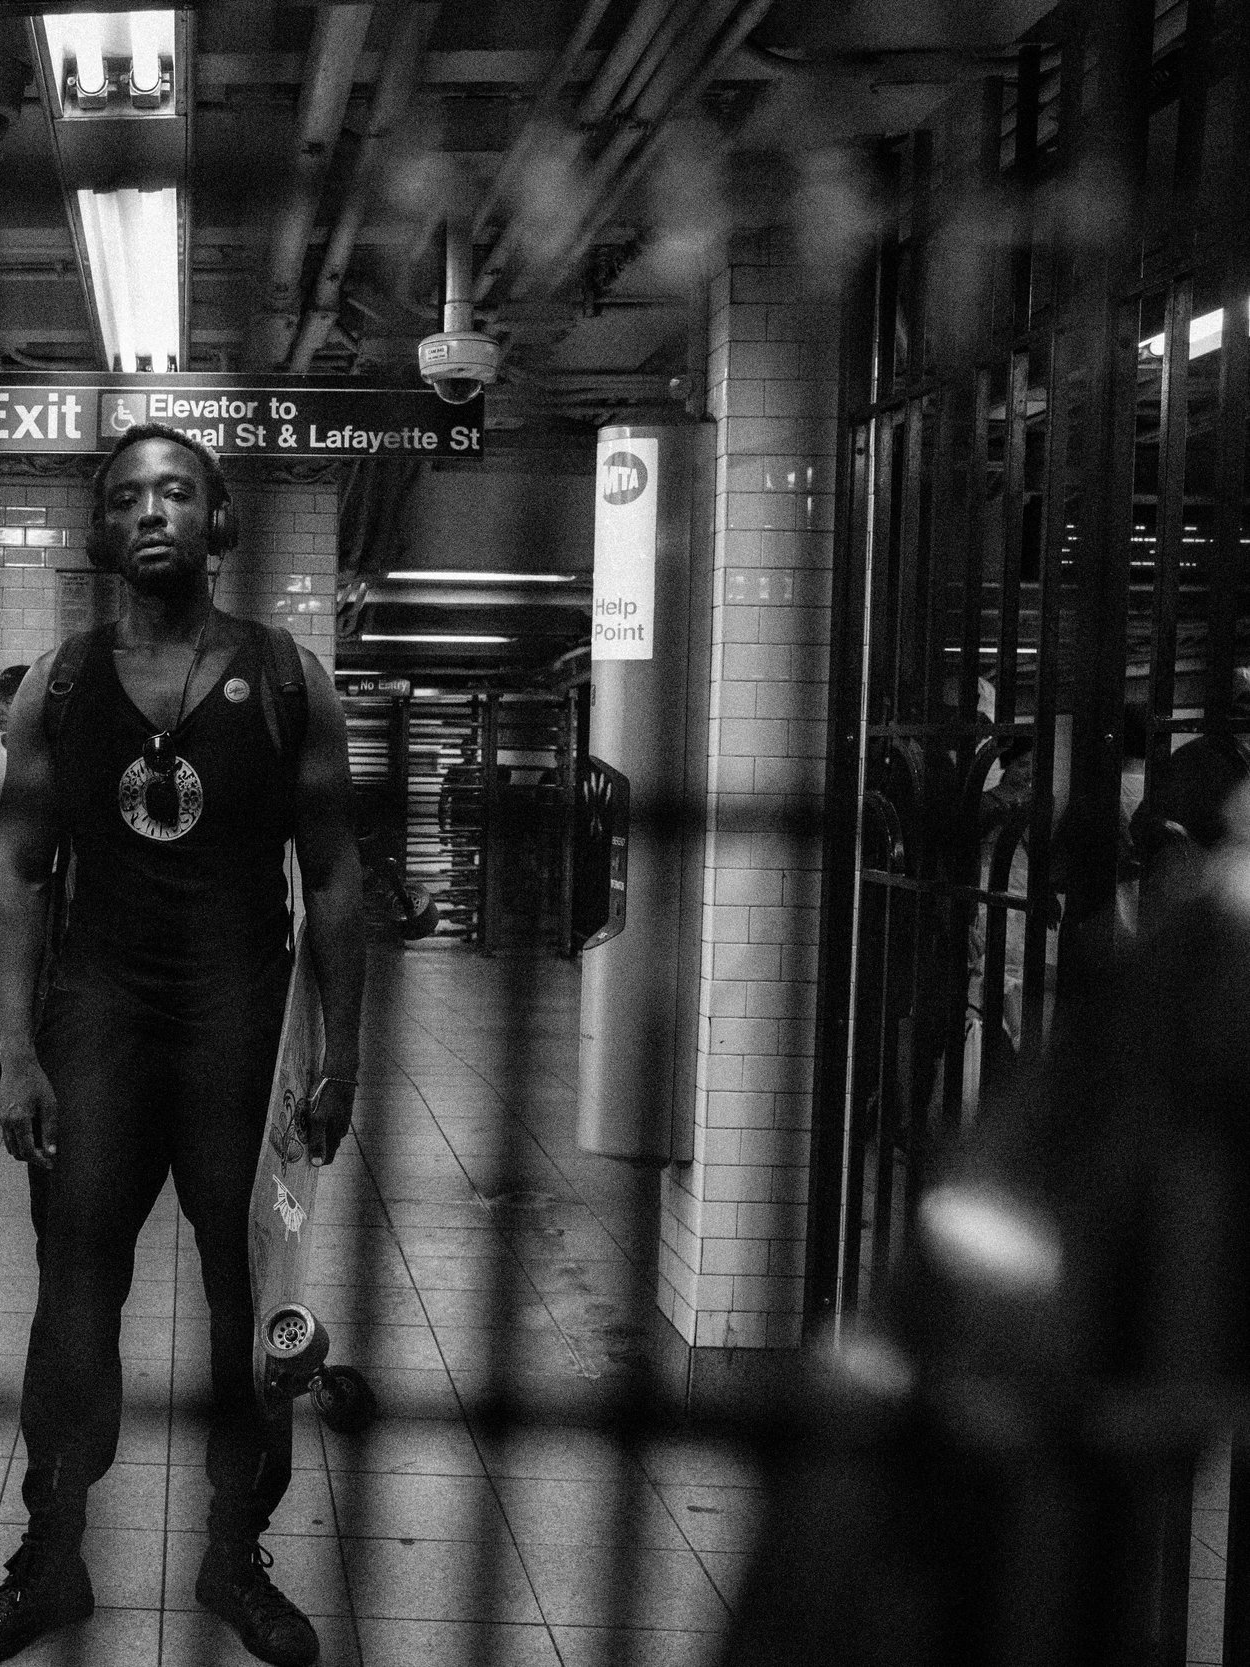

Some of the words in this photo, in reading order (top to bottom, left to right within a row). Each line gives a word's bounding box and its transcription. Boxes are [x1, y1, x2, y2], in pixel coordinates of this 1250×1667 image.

[149, 394, 258, 419] Elevator
[270, 397, 296, 419] to
[235, 423, 267, 447] St
[278, 424, 298, 447] &
[309, 424, 439, 453] Lafayette
[449, 425, 481, 450] St
[600, 465, 639, 496] MTA
[595, 597, 637, 620] Help
[594, 623, 644, 641] Point
[360, 679, 375, 691] No
[378, 679, 407, 692] Entry
